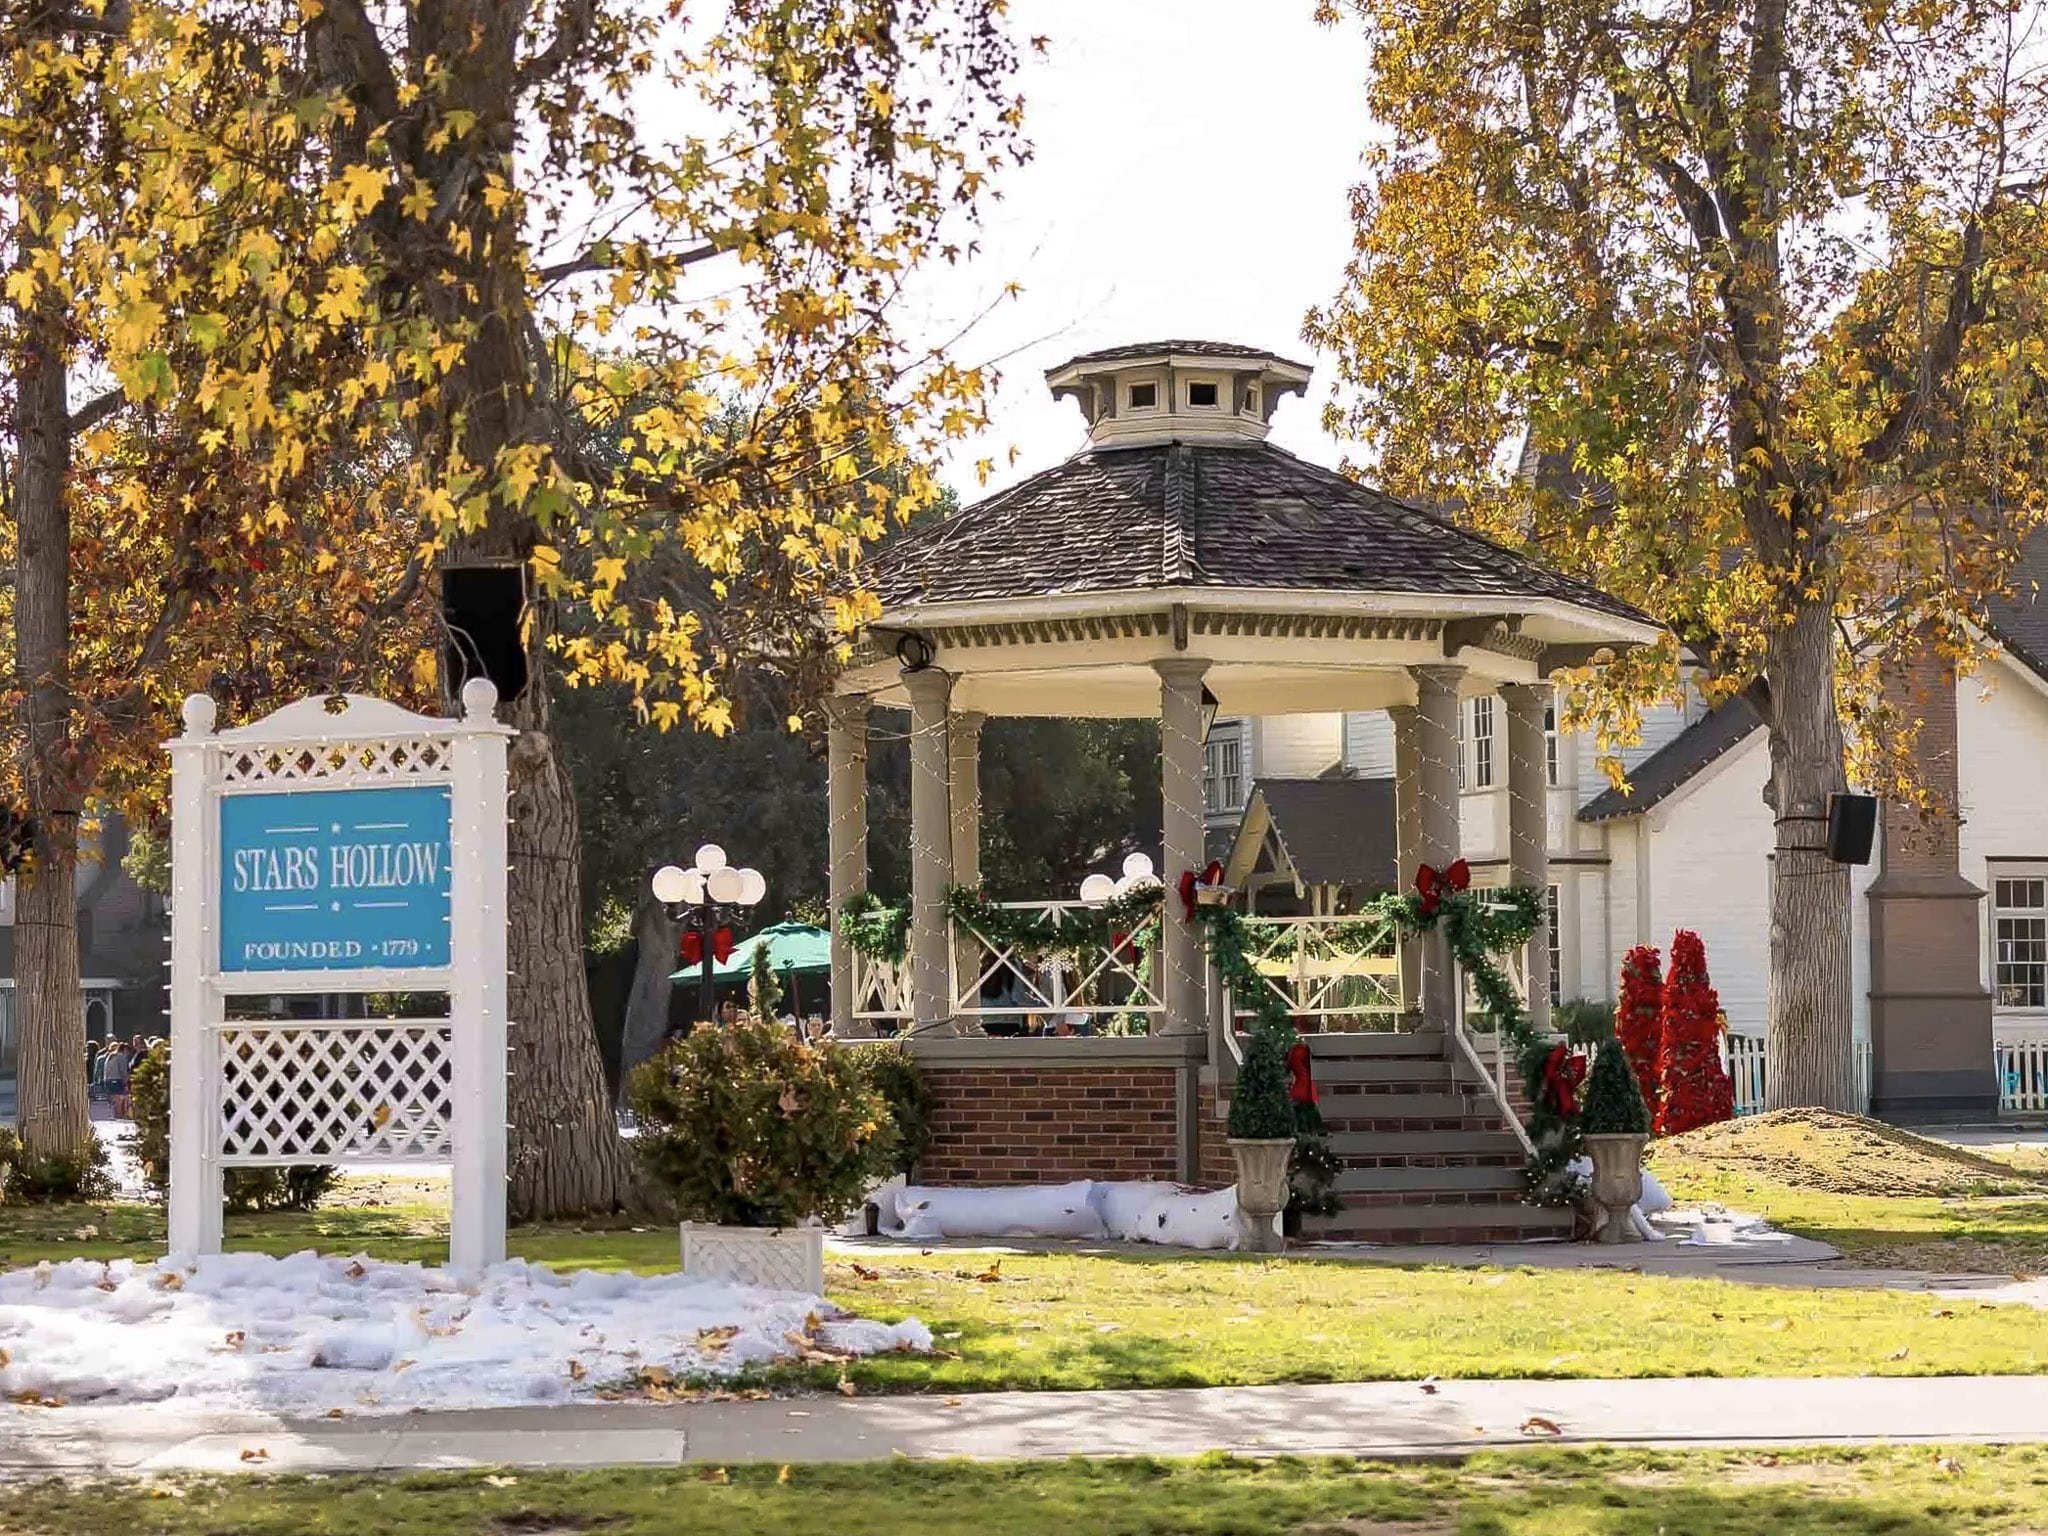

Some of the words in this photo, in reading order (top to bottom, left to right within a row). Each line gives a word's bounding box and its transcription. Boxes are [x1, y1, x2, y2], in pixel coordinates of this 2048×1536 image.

[233, 846, 319, 892] STARS
[329, 842, 441, 888] HOLLOW
[244, 940, 362, 960] FOUNDED
